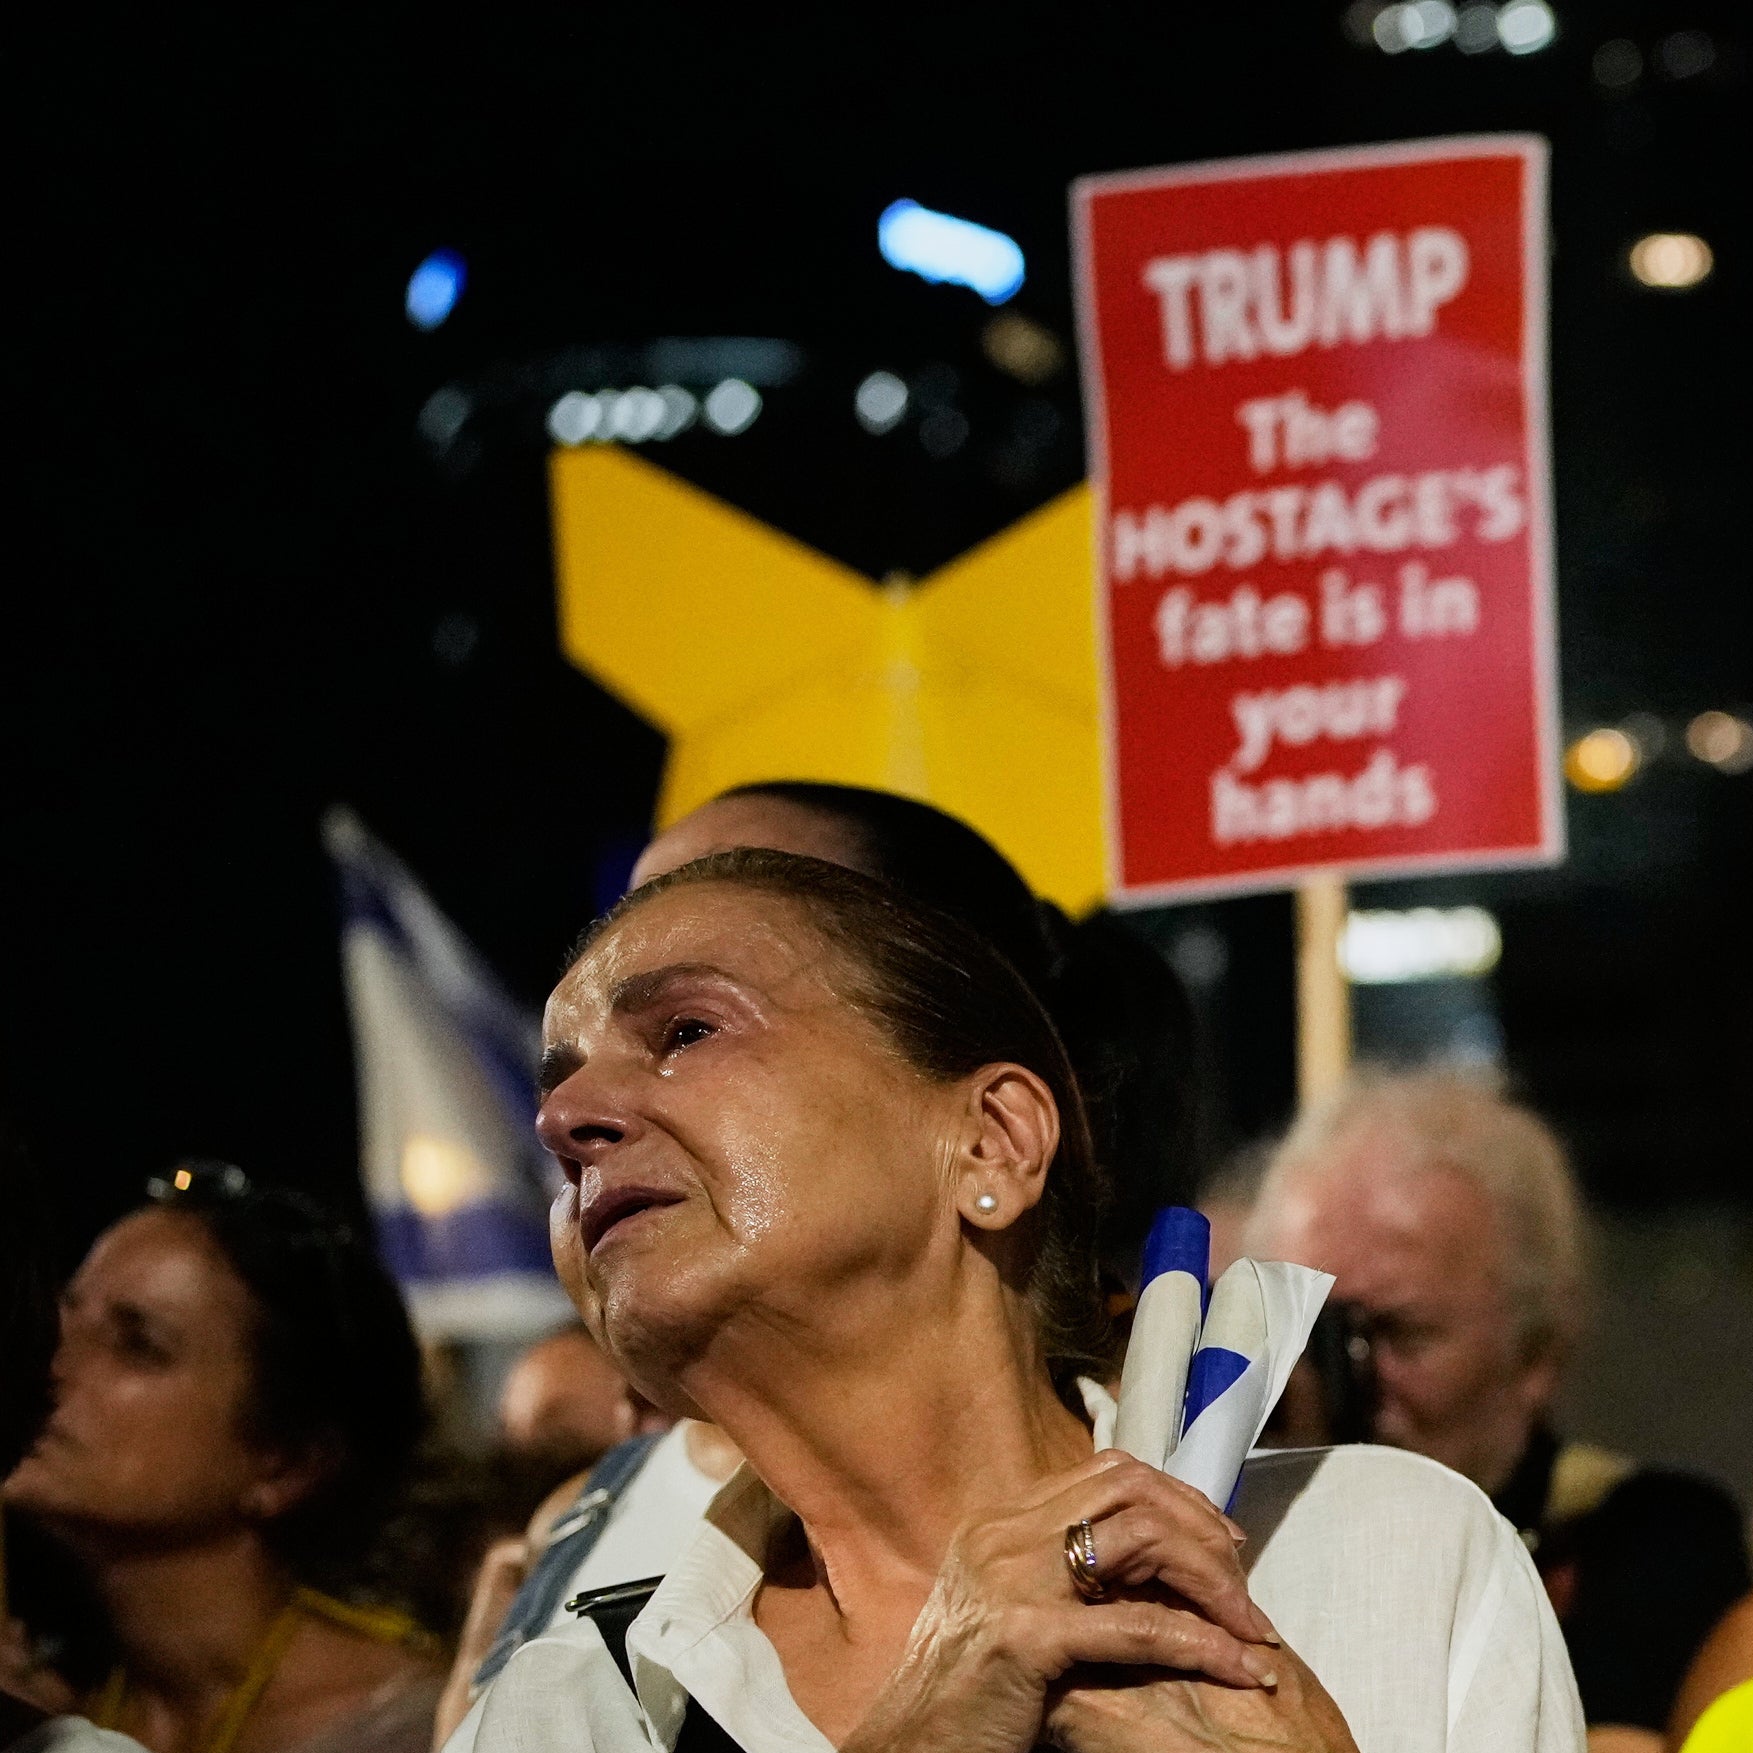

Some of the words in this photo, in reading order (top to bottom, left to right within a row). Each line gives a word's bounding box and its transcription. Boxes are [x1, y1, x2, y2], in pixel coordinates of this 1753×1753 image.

[1143, 227, 1470, 371] TRUMP
[1237, 389, 1379, 473] The
[1114, 464, 1524, 584] HOSTAGE'S
[1156, 586, 1310, 668] fate
[1320, 568, 1385, 646] is
[1399, 561, 1479, 638] in
[1232, 673, 1404, 771] your
[1212, 751, 1435, 846] hands
